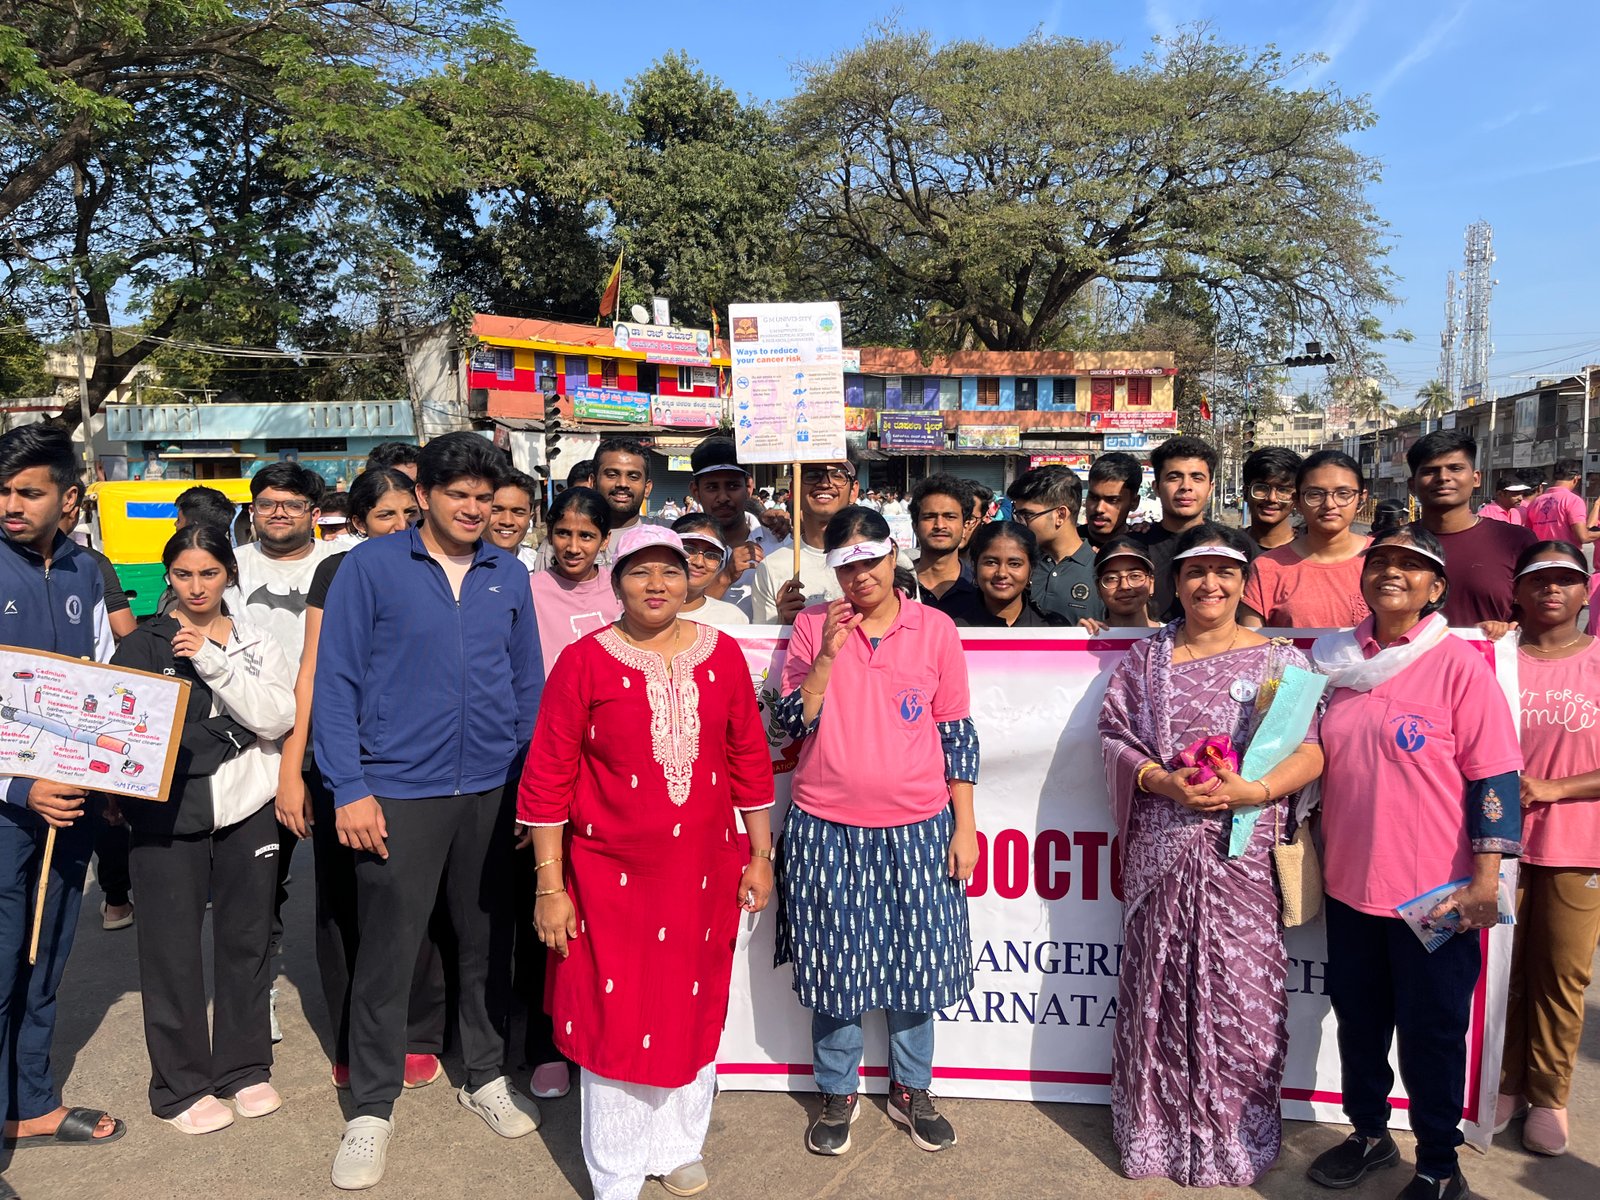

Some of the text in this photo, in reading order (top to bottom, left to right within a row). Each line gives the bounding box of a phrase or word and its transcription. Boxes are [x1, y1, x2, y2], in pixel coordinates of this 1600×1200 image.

[736, 348, 758, 356] Ways
[760, 347, 769, 355] to
[35, 668, 67, 679] Cadmium
[48, 700, 78, 710] Hexamine
[1545, 688, 1600, 716] FORGET
[80, 711, 106, 720] Toluene
[1519, 701, 1596, 733] mile
[1, 731, 30, 739] Methane
[128, 732, 160, 740] Ammonia
[54, 745, 78, 753] Carbon
[53, 751, 85, 760] Monoxide
[57, 763, 87, 772] Methanol
[970, 940, 1124, 977] ANGER
